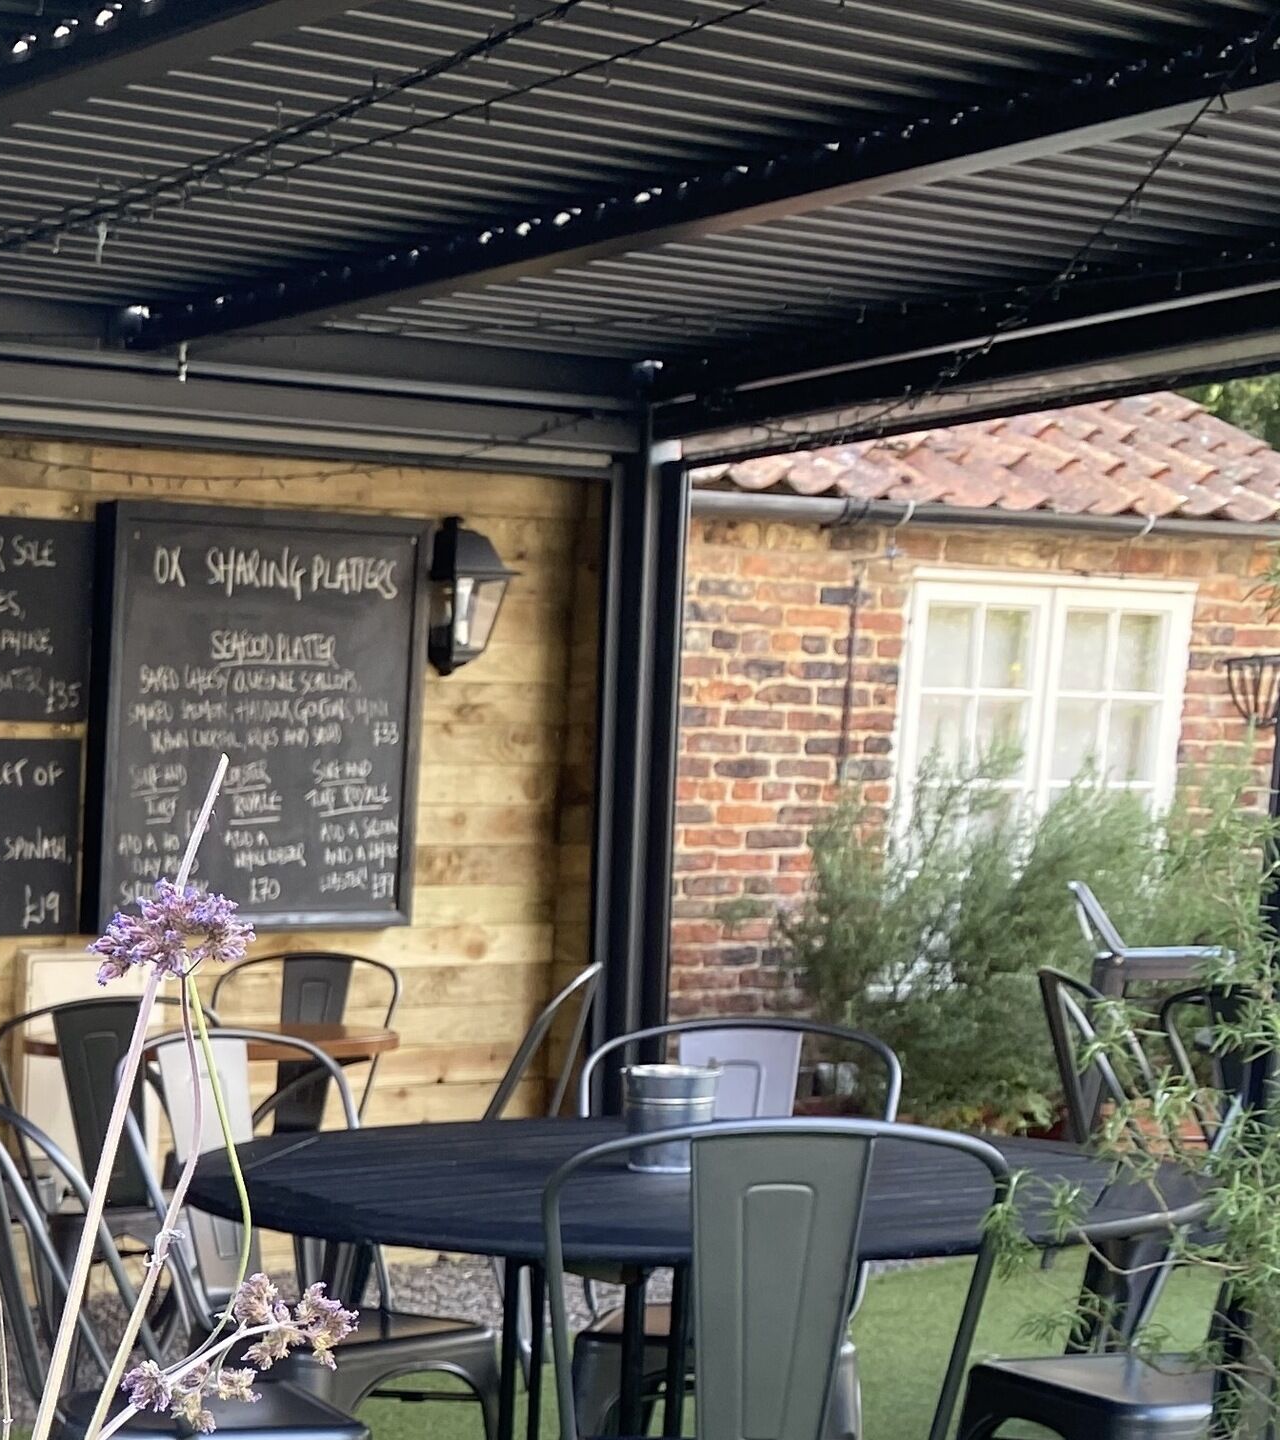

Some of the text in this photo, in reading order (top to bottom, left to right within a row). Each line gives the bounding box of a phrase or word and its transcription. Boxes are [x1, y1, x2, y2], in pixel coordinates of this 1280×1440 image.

[12, 534, 57, 567] SOLE
[153, 545, 398, 601] OX SHARING PLATTERS
[33, 760, 64, 786] OF
[22, 884, 60, 930] £19
